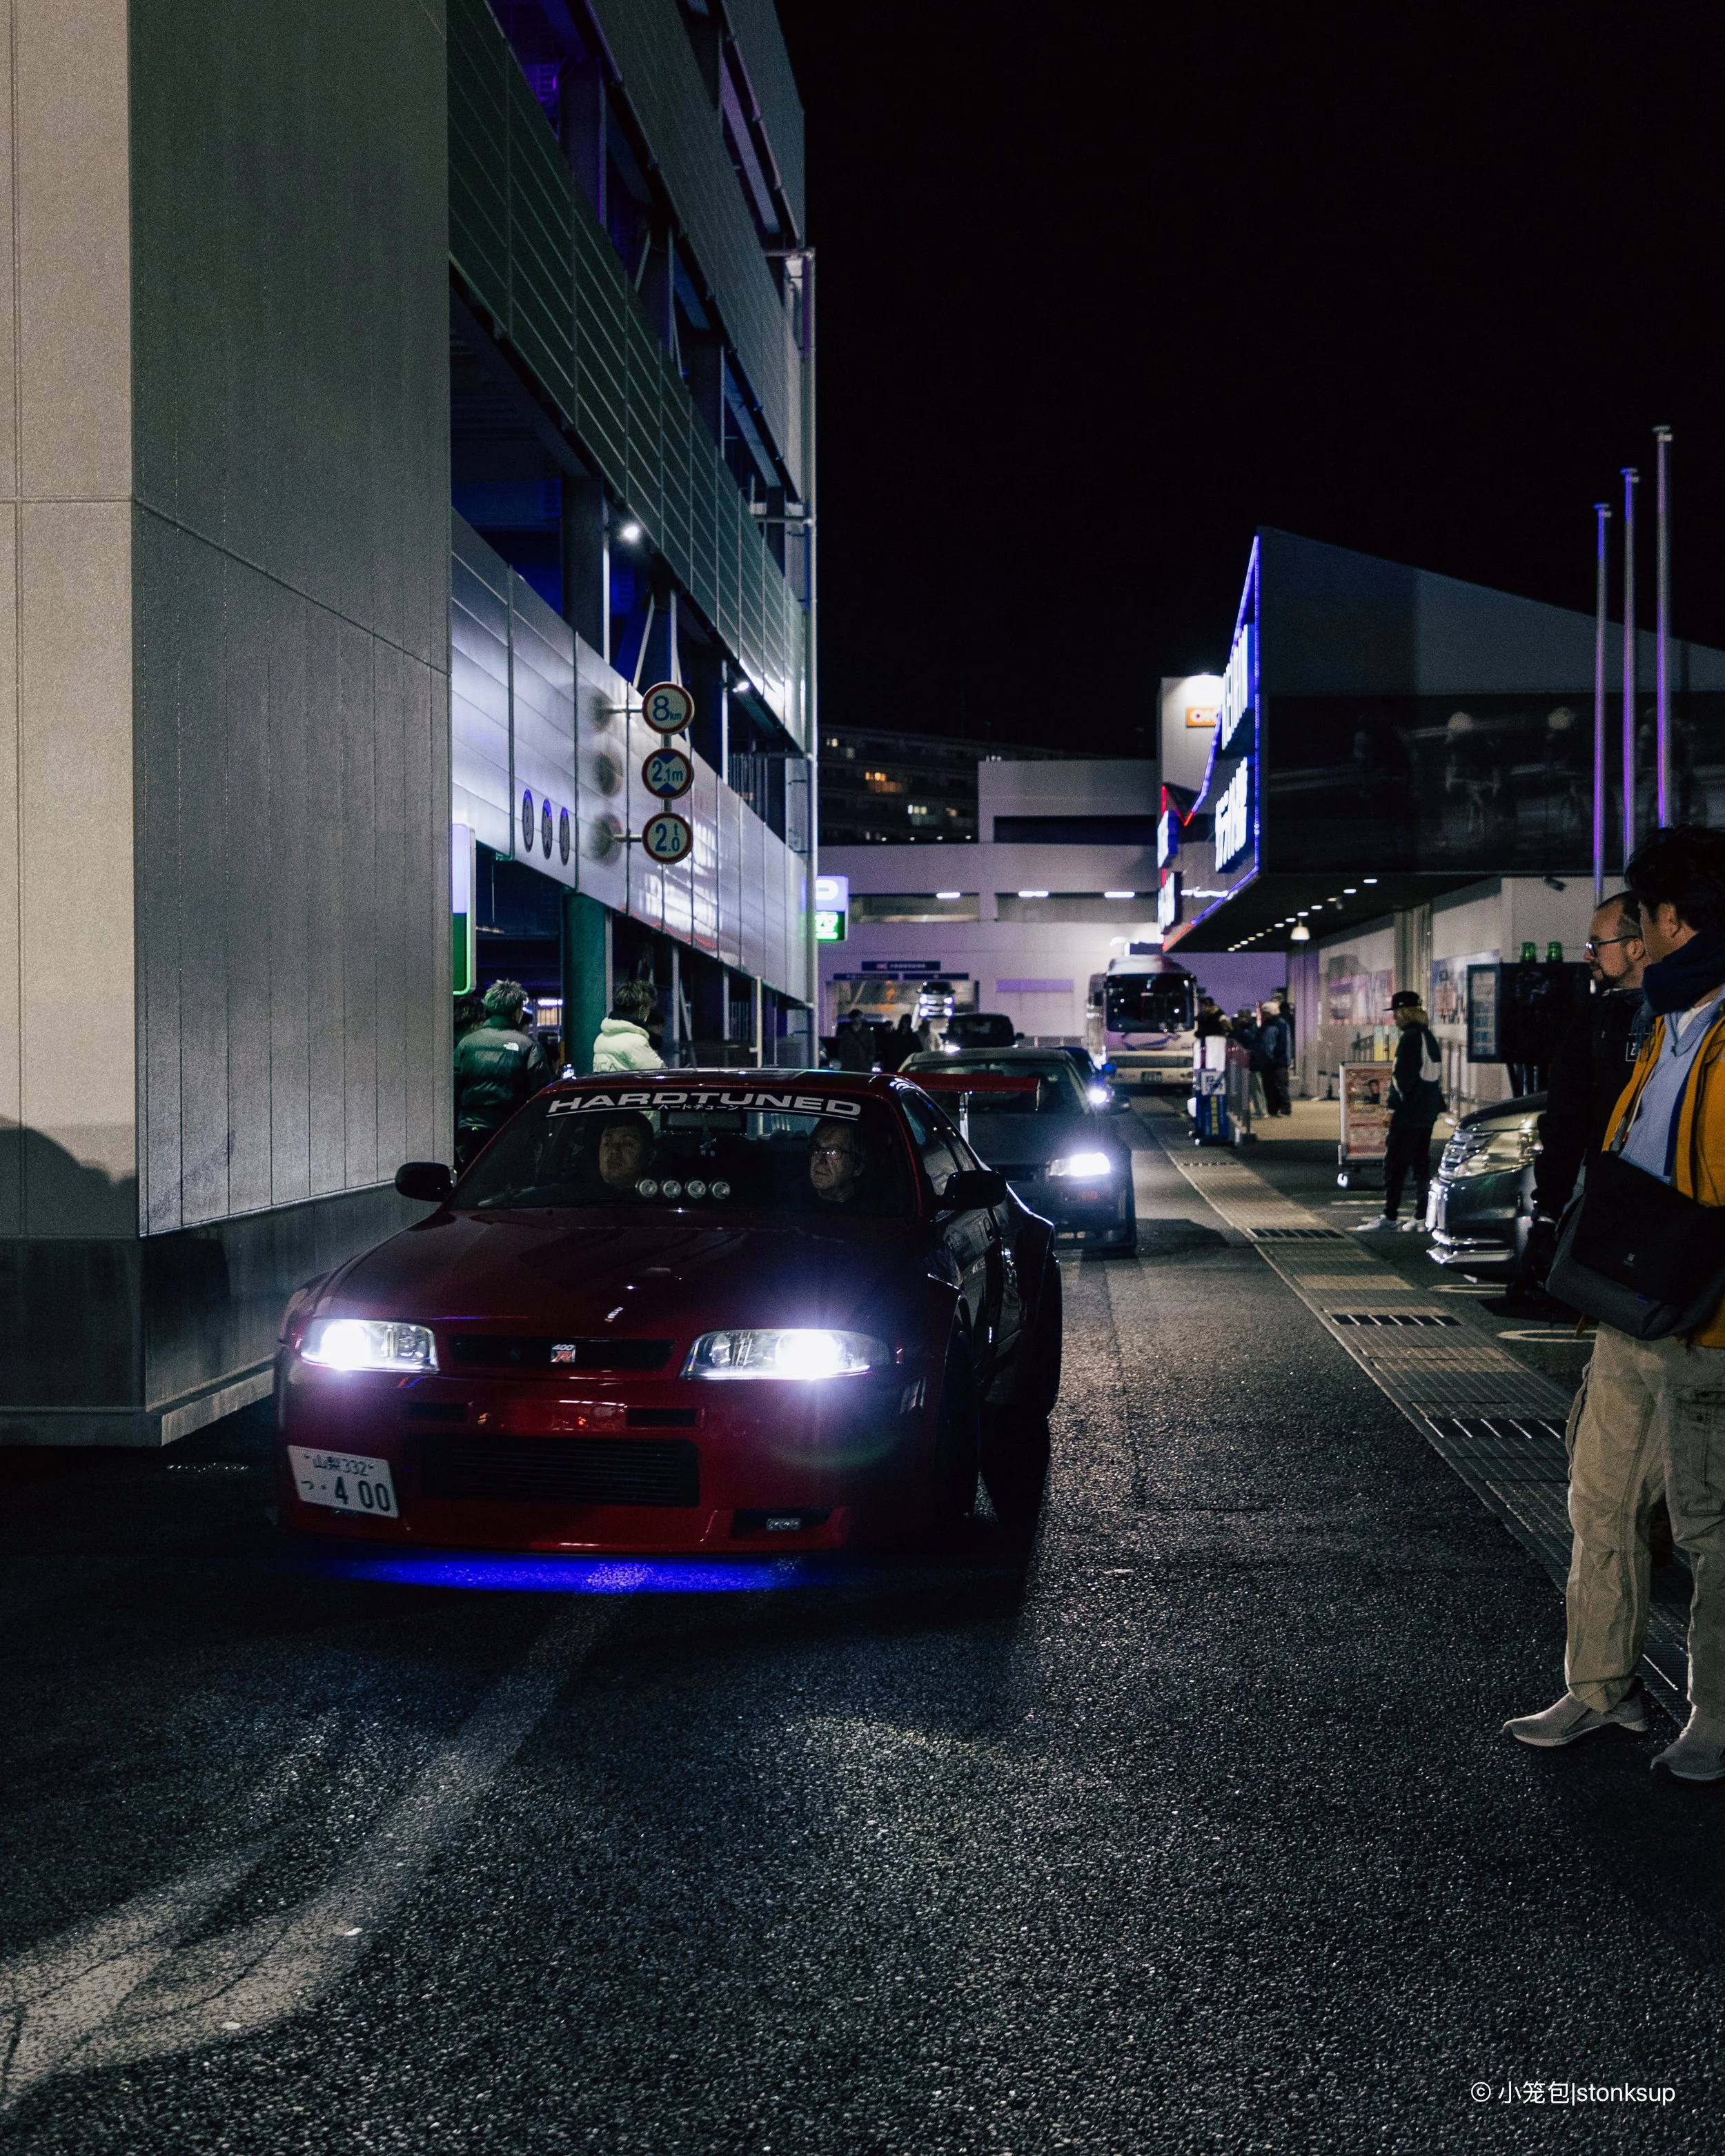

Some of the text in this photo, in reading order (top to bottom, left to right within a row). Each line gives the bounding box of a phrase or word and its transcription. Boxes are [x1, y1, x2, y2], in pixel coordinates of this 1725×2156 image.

[651, 760, 684, 782] 2.1m
[547, 1092, 862, 1116] HARDTUNED
[551, 1351, 572, 1363] R
